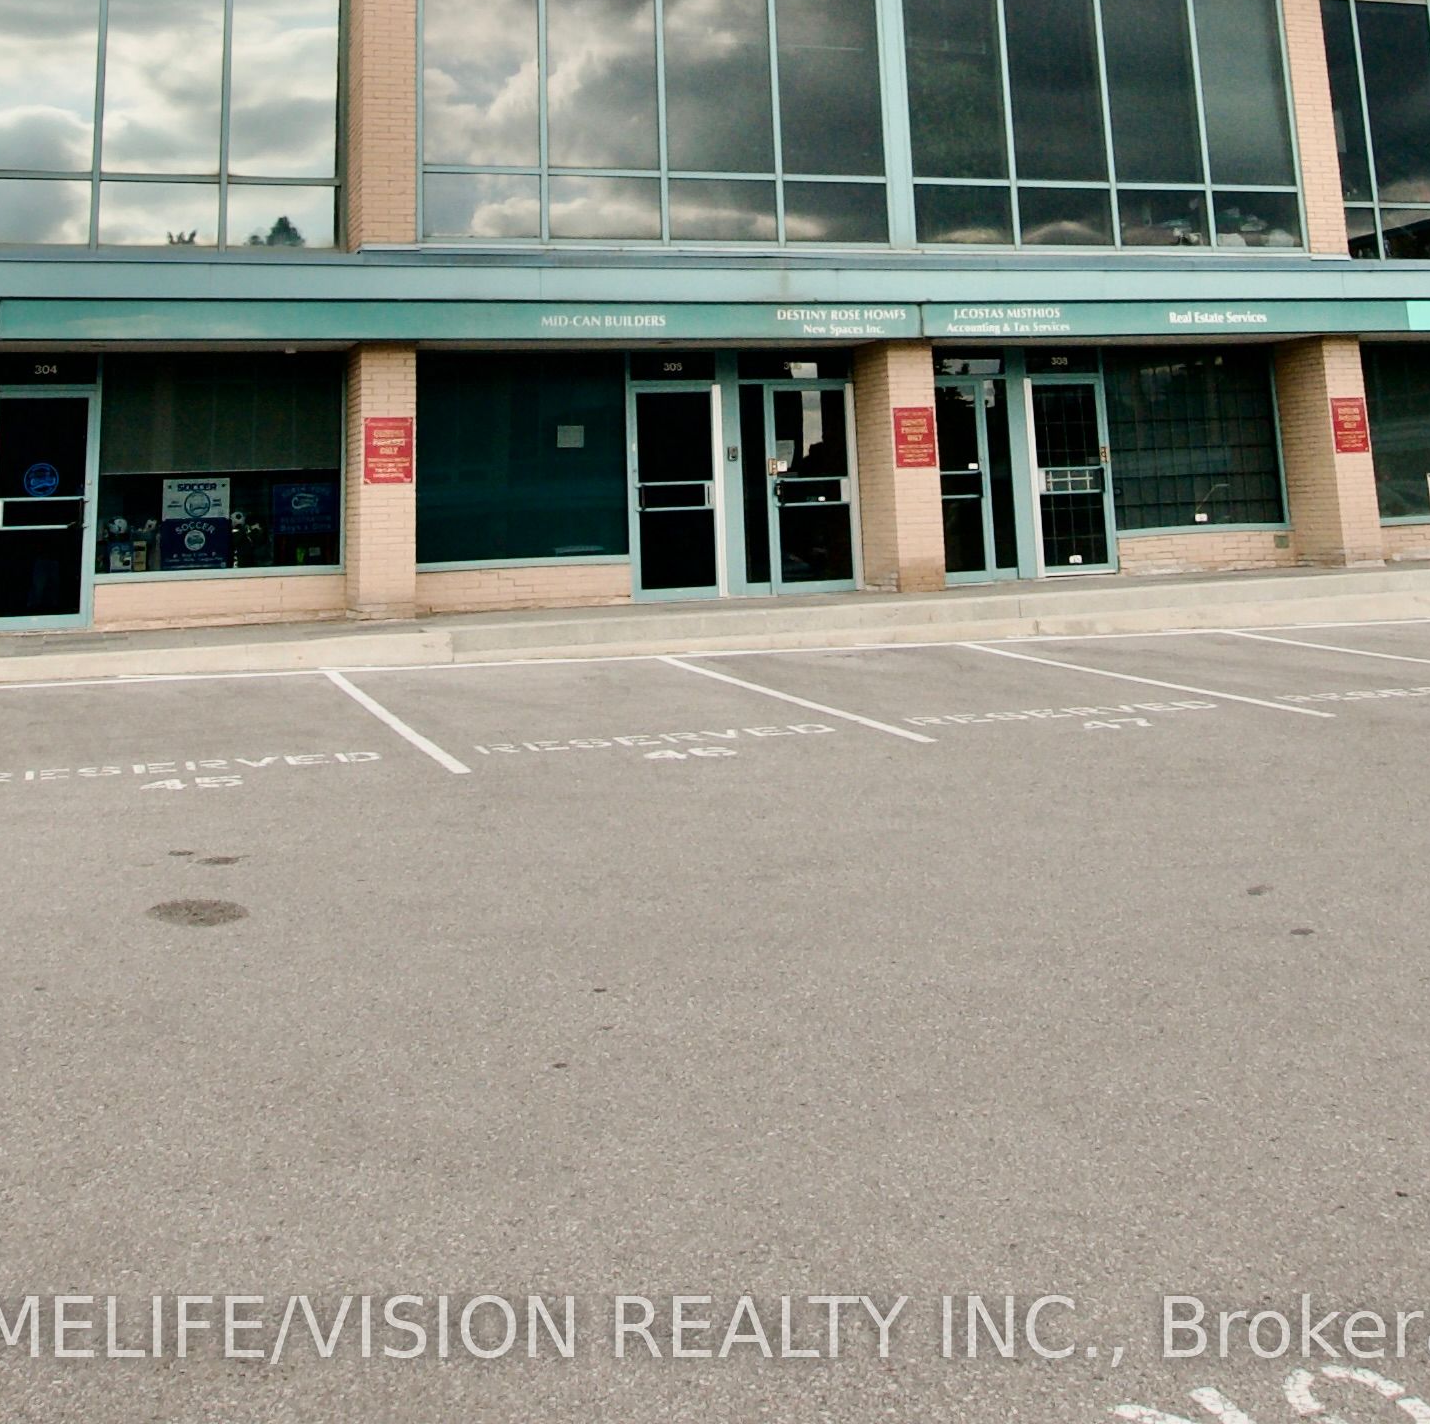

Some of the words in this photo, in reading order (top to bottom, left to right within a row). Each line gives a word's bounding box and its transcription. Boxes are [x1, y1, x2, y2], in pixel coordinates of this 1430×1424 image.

[777, 309, 826, 320] DESTINY
[830, 309, 861, 320] ROSE
[953, 309, 1003, 319] J.COSTAS
[1007, 308, 1060, 318] MISTHIOS
[1170, 311, 1191, 323] Real
[1195, 311, 1223, 323] Estate
[1227, 311, 1267, 323] Services
[541, 316, 601, 327] MID-CAN
[604, 315, 666, 326] BUILDERS
[803, 324, 826, 333] New
[830, 324, 863, 336] Spaces
[867, 324, 885, 334] Inc.
[947, 323, 1000, 334] Accounting
[1003, 323, 1011, 332] &
[1014, 323, 1030, 332] Tax
[1033, 322, 1070, 332] Services
[34, 364, 58, 375] 304
[178, 483, 217, 491] SOCCER
[174, 520, 216, 535] SOCCER
[902, 700, 1218, 727] RESERVED
[1083, 717, 1154, 729] 47
[473, 723, 837, 755] RESERVED
[643, 746, 738, 760] 46
[139, 775, 244, 790] 45
